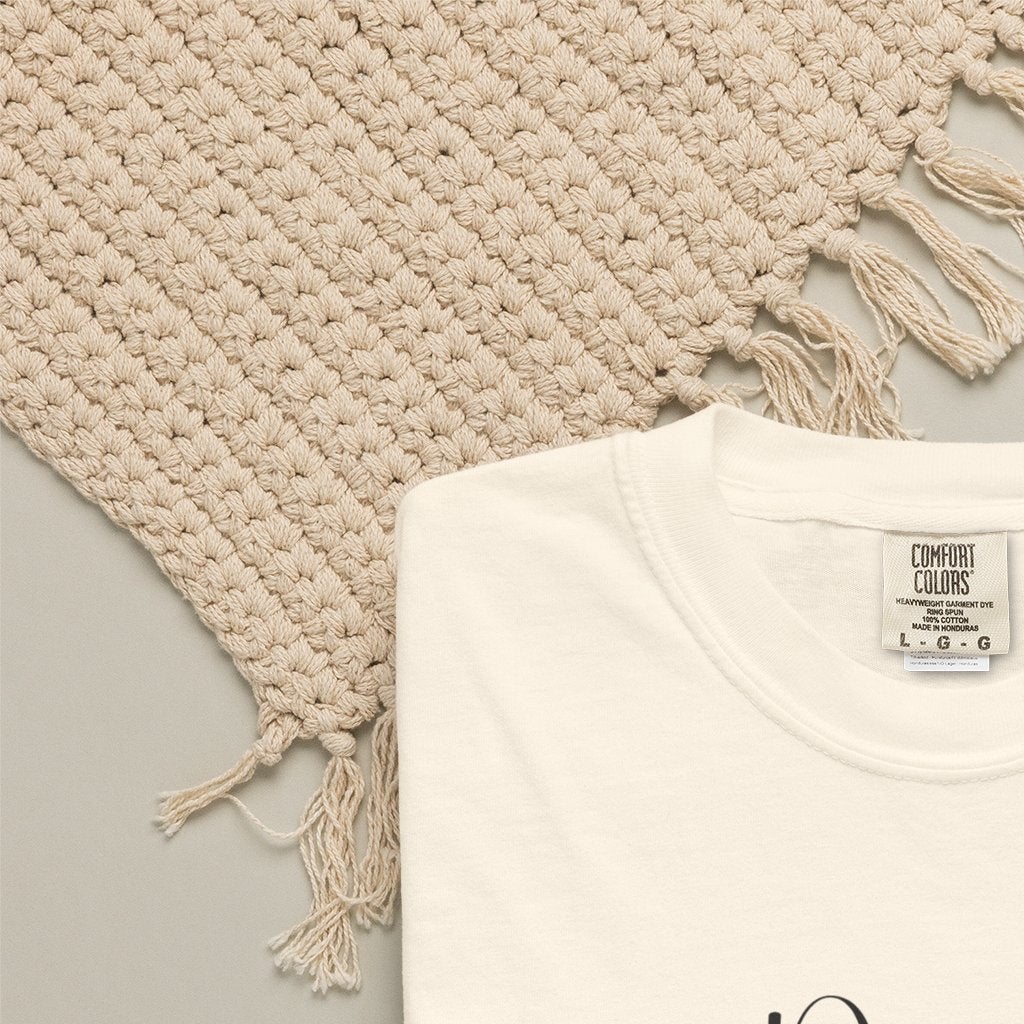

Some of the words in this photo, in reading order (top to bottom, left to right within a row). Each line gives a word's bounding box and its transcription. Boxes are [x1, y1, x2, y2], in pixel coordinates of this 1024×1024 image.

[911, 543, 975, 568] COMFORT
[896, 598, 944, 608] HEAVYWEIGHT
[945, 600, 978, 609] GARMENT
[980, 601, 994, 609] DYE
[926, 608, 943, 616] RING
[945, 608, 964, 616] SPUN
[922, 616, 939, 624] 100%
[941, 616, 969, 624] COTTON
[912, 622, 932, 632] MADE
[933, 624, 940, 632] IN
[936, 635, 951, 650] G
[977, 636, 991, 650] G
